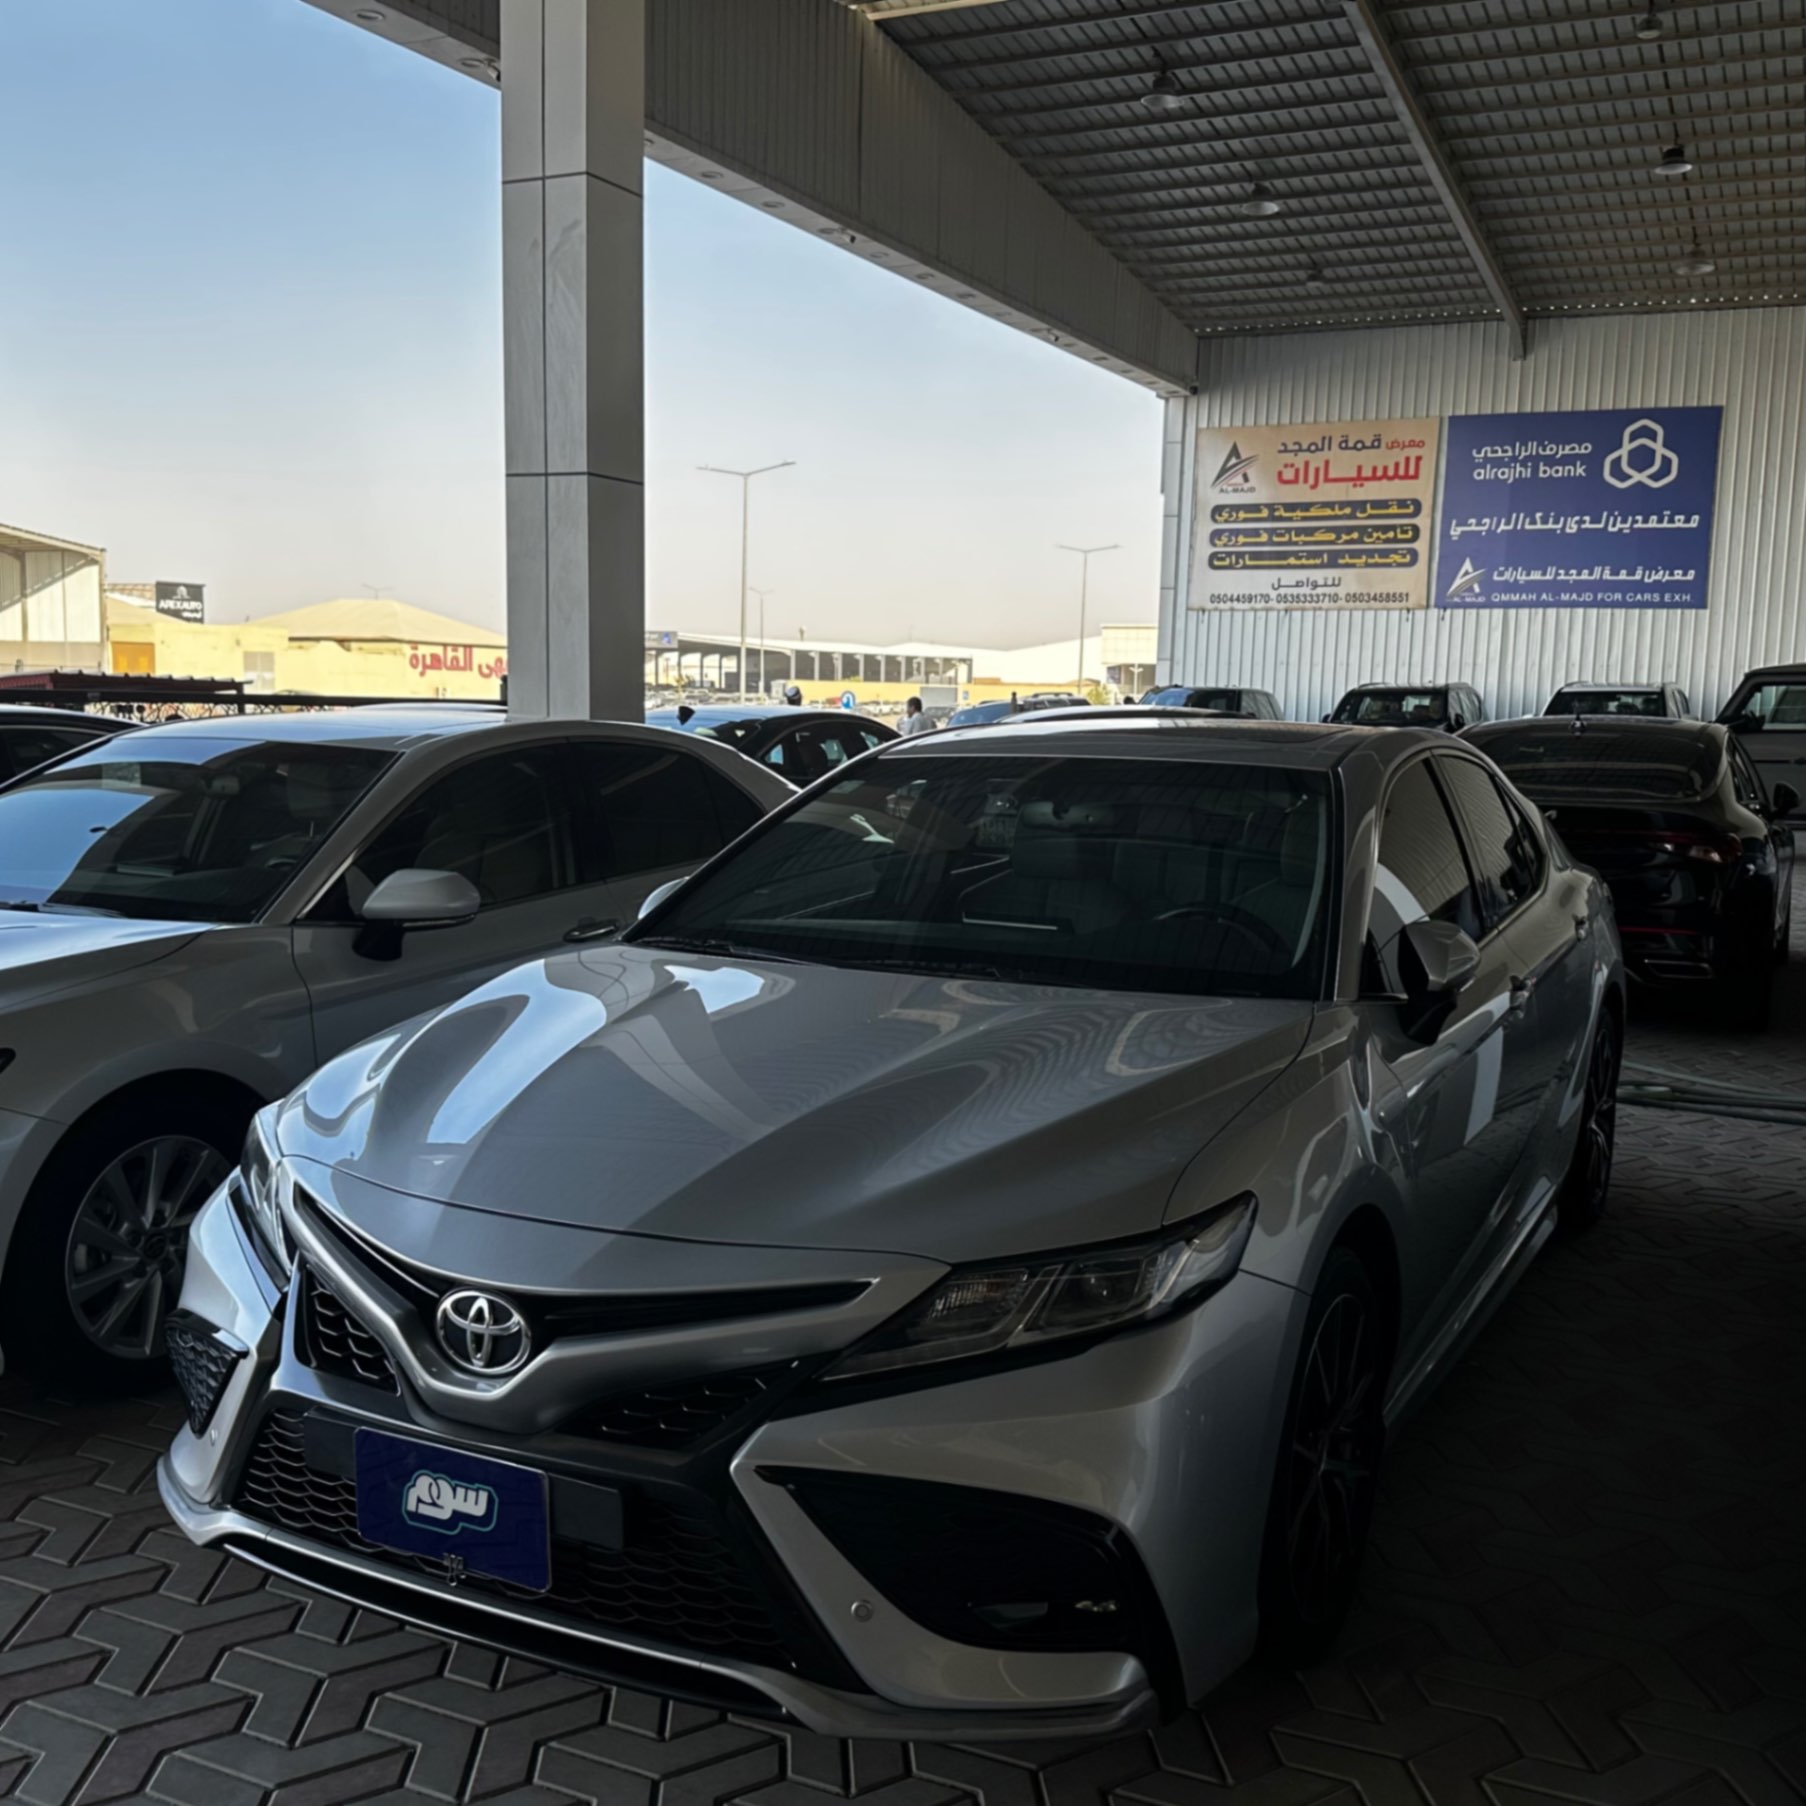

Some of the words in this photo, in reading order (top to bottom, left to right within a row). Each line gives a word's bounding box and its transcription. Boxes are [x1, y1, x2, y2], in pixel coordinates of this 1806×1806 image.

[1277, 436, 1332, 456] المجد
[1338, 434, 1382, 450] قمة
[1385, 439, 1425, 450] معرض
[1538, 440, 1592, 459] مصرف
[1472, 441, 1537, 462] الراجحي
[1277, 455, 1423, 490] للسيارات
[1473, 462, 1532, 484] alrajhi
[1538, 460, 1587, 478] bank
[1215, 505, 1269, 522] فوري
[1274, 504, 1351, 519] ملكية
[1356, 501, 1414, 518] نقل
[1450, 513, 1524, 540] الراجحي
[1607, 510, 1700, 533] معتمدين
[1215, 529, 1269, 546] فوري
[1272, 529, 1358, 545] مركبات
[1213, 553, 1328, 568] استمارات
[1337, 550, 1411, 567] تجديد
[1492, 566, 1556, 584] للسيارات
[1556, 566, 1602, 583] المجد
[1602, 566, 1643, 580] قمة
[1644, 566, 1695, 582] معرض
[1271, 577, 1342, 590] للتواصل
[1345, 592, 1409, 603] 0503458551
[1491, 593, 1537, 602] QMMAH
[1540, 593, 1593, 602] AL-MAJD
[1597, 593, 1622, 602] FOR
[1626, 592, 1660, 602] CARS
[1664, 593, 1691, 602] EXH
[409, 642, 473, 677] القاهرة
[406, 1475, 488, 1520] سوم
